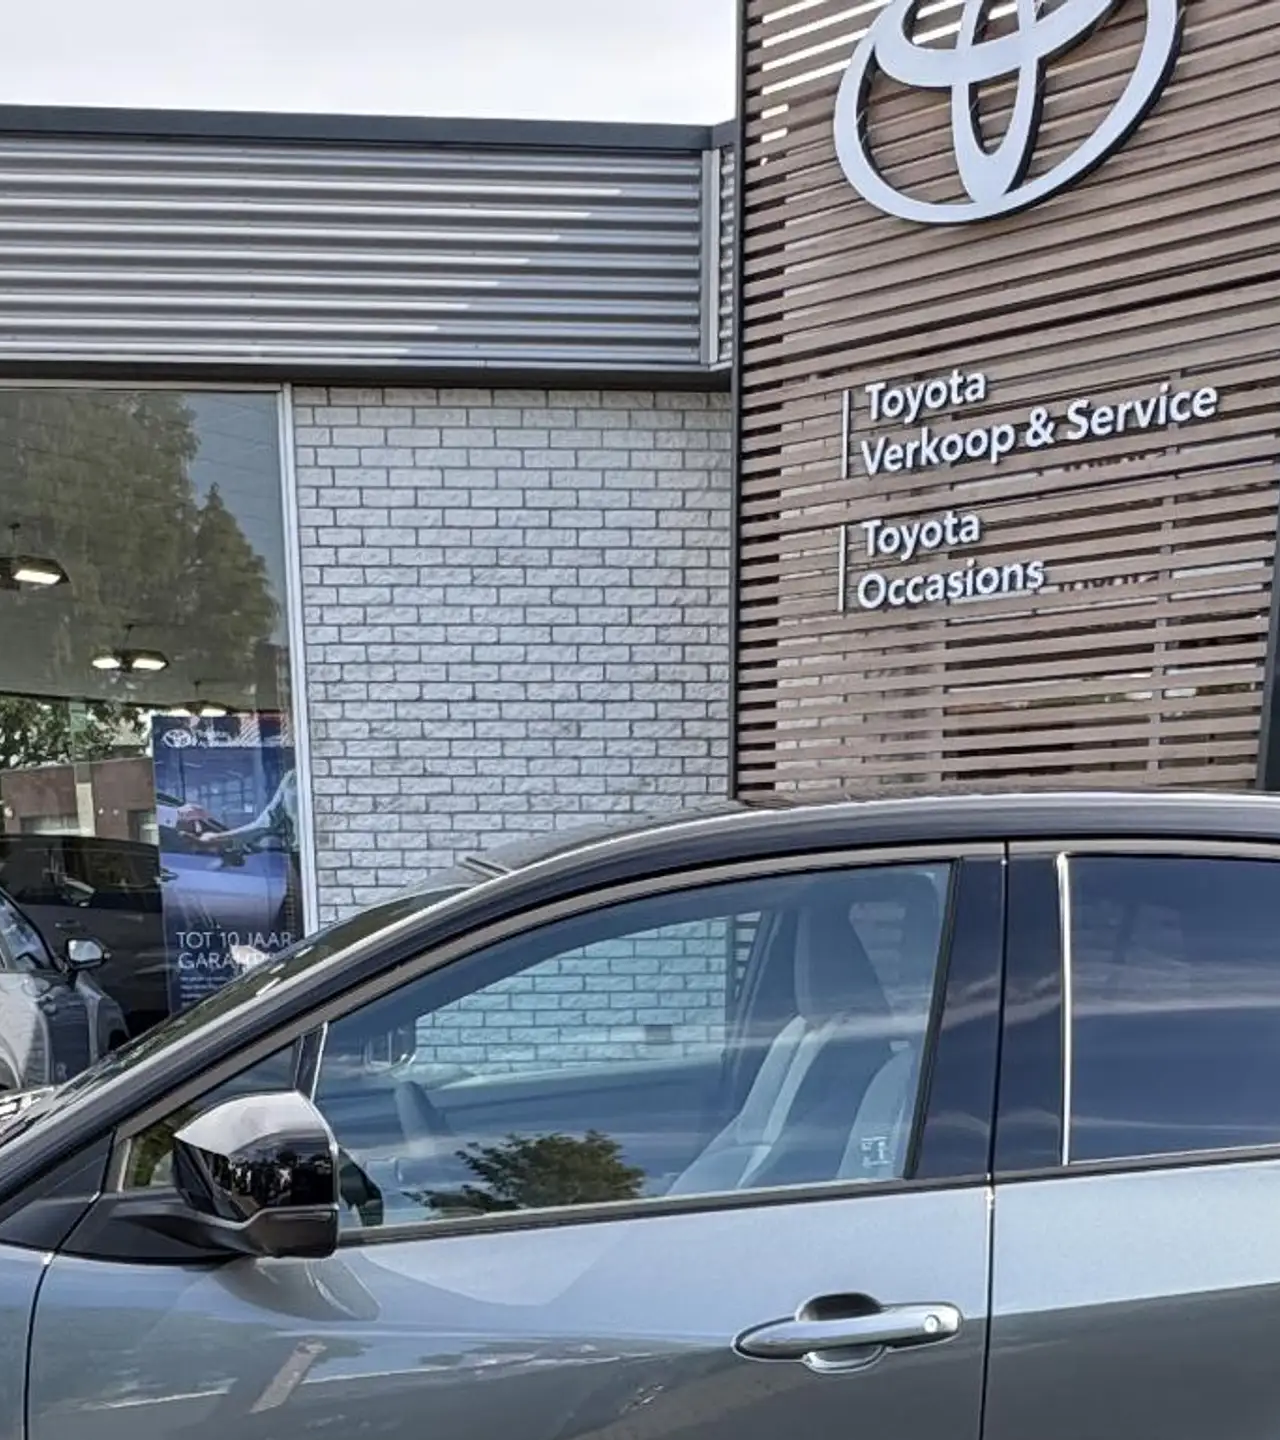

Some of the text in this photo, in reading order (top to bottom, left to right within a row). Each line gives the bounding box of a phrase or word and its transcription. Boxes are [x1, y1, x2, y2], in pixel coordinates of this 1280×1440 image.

[865, 369, 986, 424] Toyota
[861, 382, 1218, 475] Verkoop & Service
[861, 511, 980, 561] Toyota
[857, 558, 1044, 609] Occasions
[176, 931, 212, 949] TOT
[220, 931, 240, 949] 10
